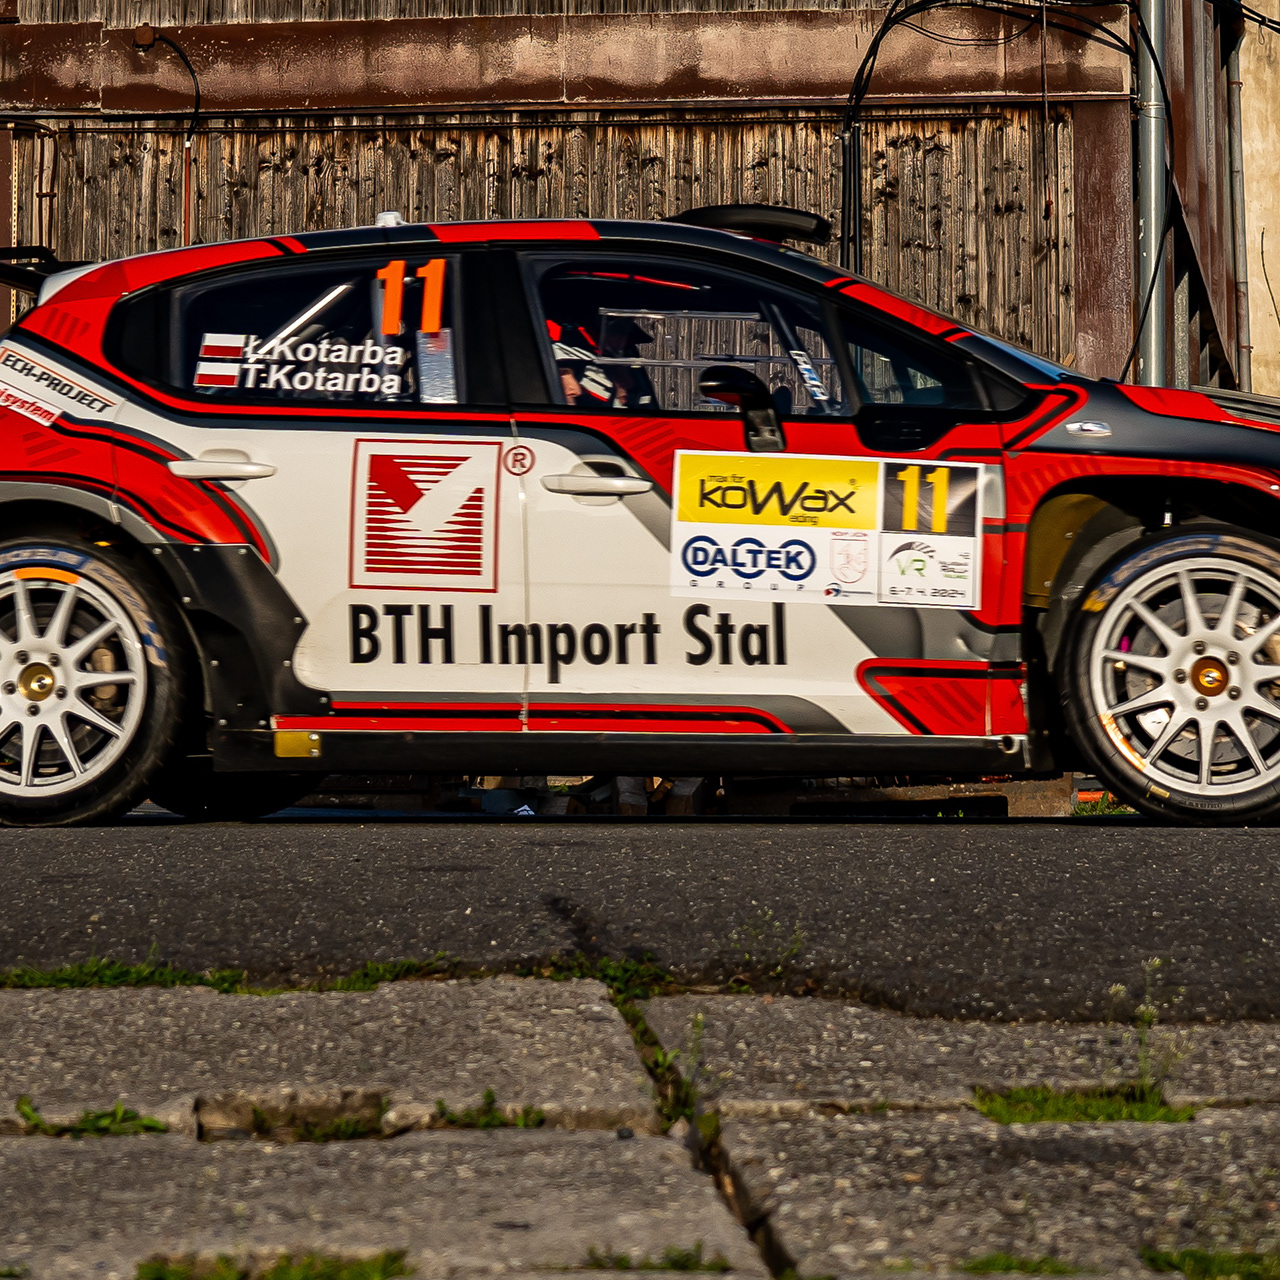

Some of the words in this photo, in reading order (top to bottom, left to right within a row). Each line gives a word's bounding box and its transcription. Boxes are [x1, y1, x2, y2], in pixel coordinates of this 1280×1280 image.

[376, 258, 447, 335] 11
[240, 363, 402, 394] T.Kotarba
[2, 393, 58, 423] system
[896, 465, 949, 532] 11
[691, 546, 806, 570] DALTEK
[690, 579, 806, 592] GROUP
[348, 603, 455, 665] BTH
[479, 603, 661, 684] Import
[683, 602, 788, 666] Stal
